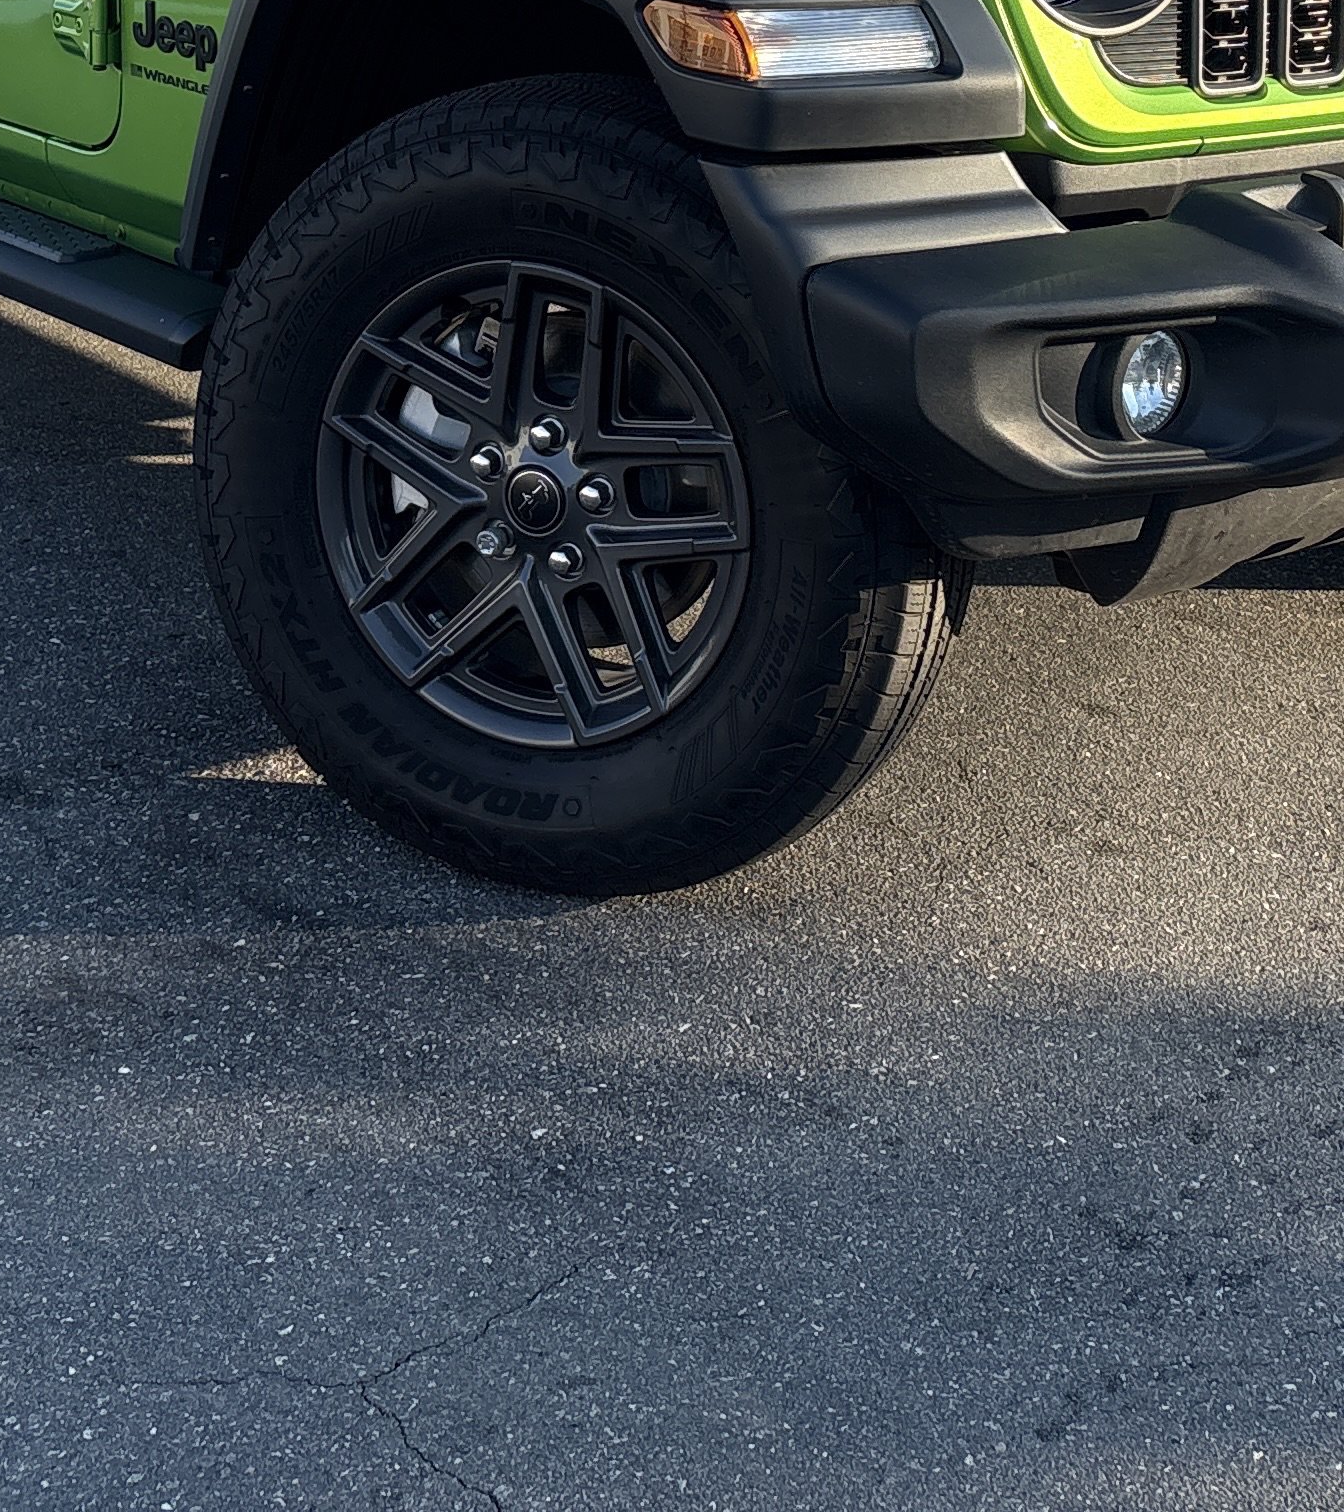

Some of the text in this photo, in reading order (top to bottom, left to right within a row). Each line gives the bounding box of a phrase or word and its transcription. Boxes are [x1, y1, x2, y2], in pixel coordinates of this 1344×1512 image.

[133, 0, 218, 72] Jeep
[545, 201, 765, 385] NEXEN
[751, 565, 809, 715] All-Weather
[336, 701, 560, 822] ROADIAN
